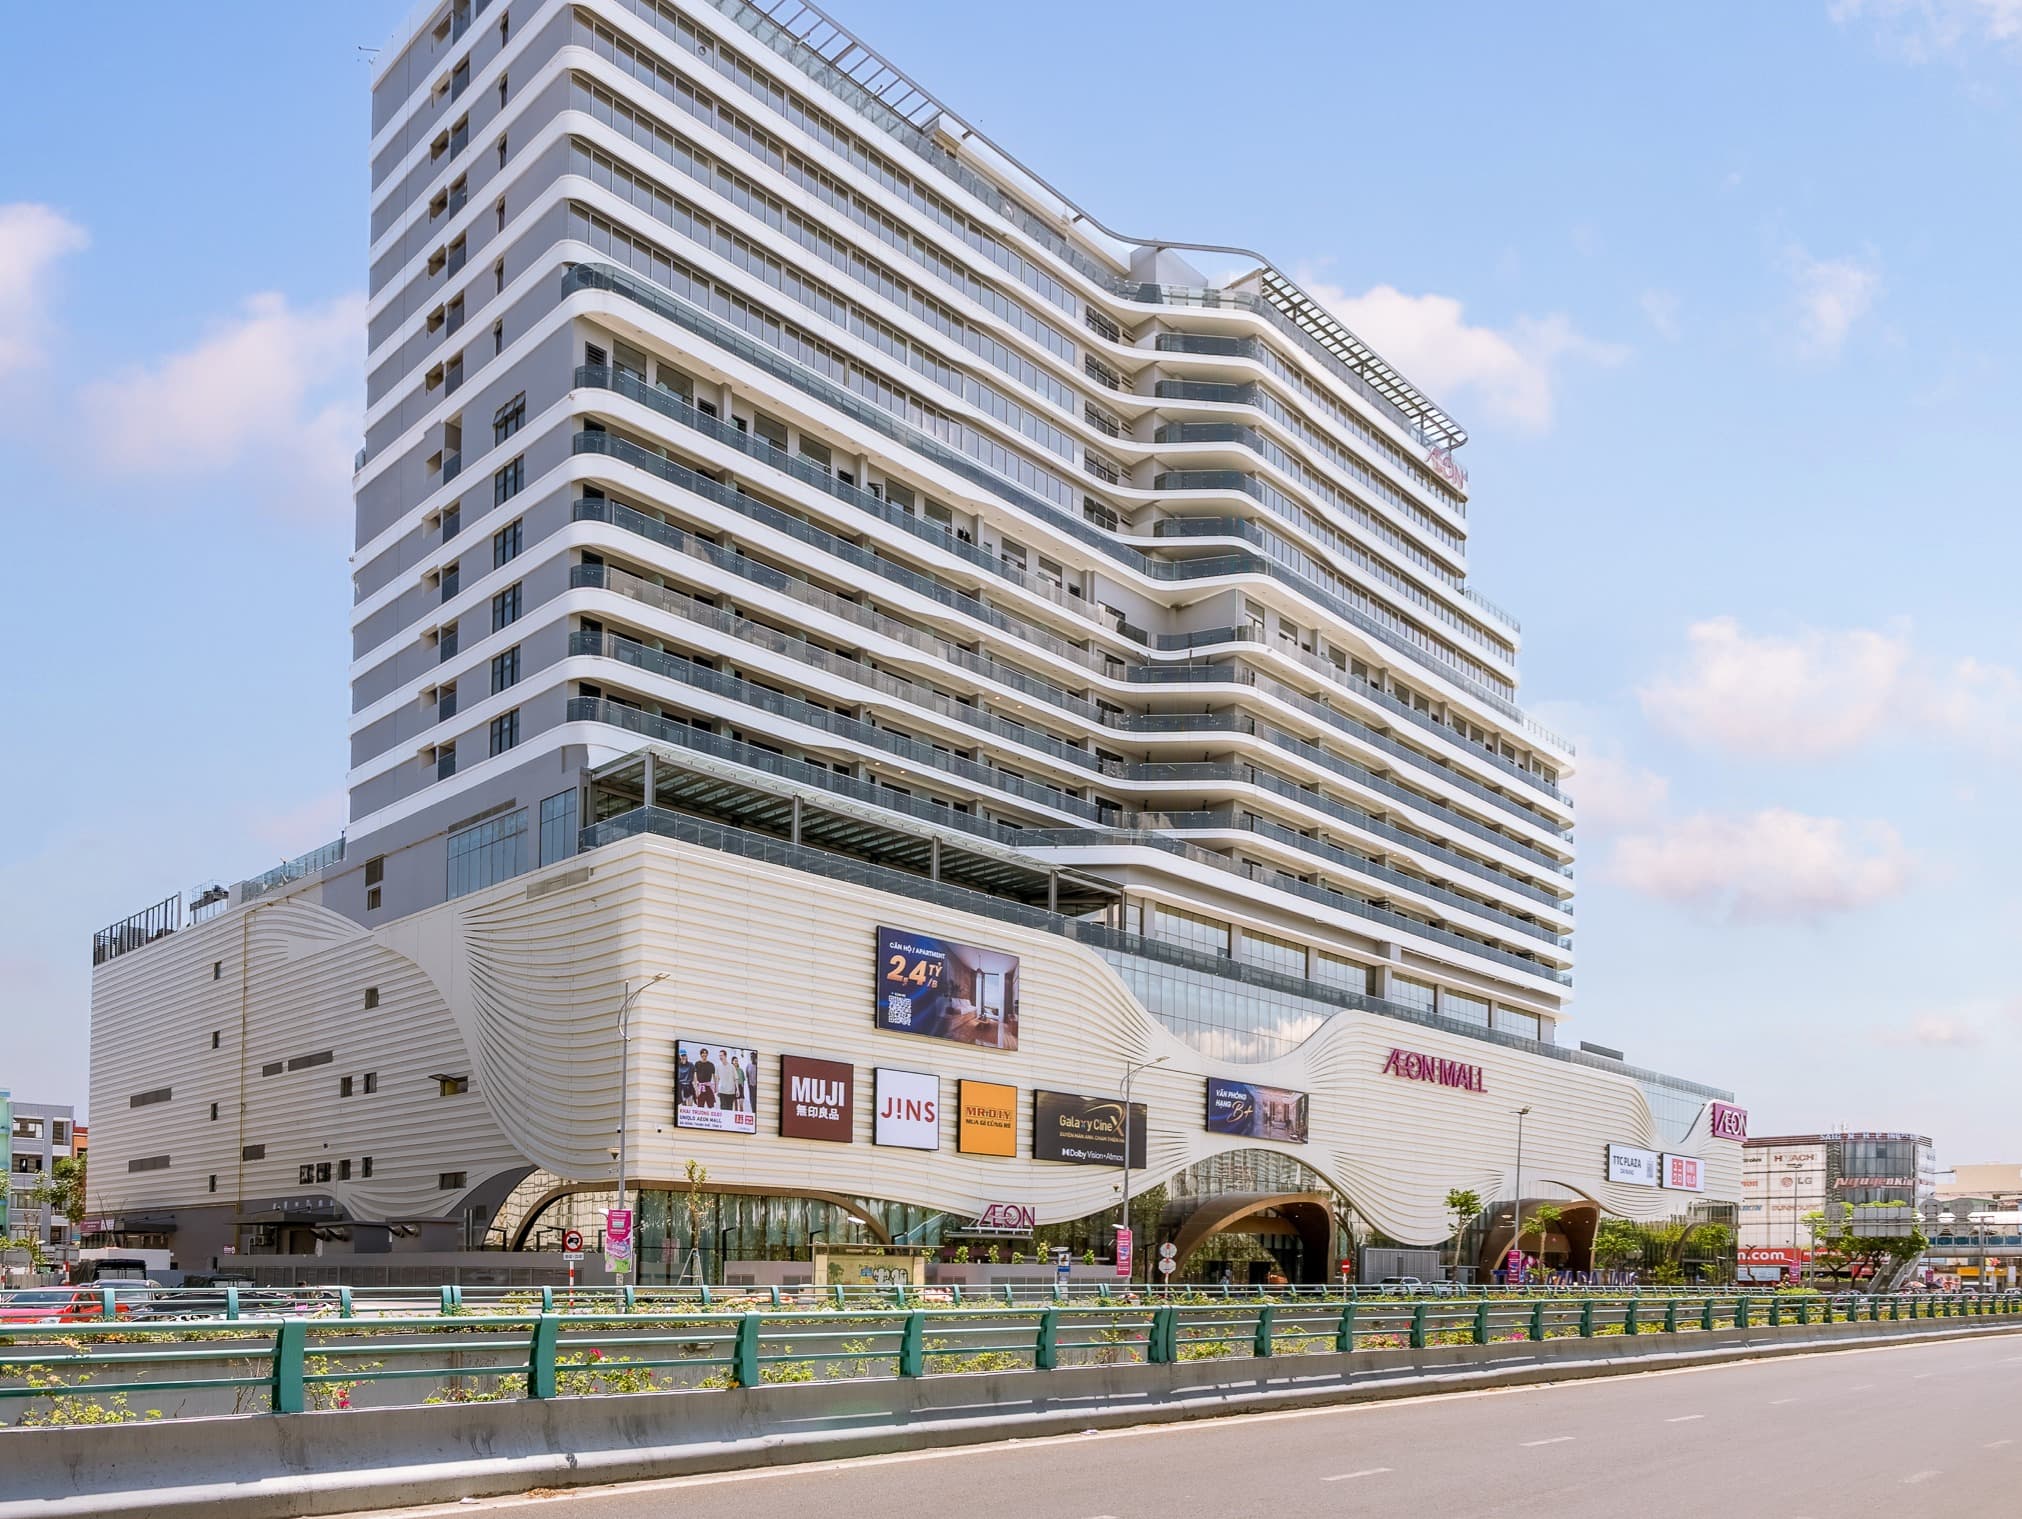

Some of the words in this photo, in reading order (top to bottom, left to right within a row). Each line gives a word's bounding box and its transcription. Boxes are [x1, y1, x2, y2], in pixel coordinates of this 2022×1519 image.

[1440, 1058, 1488, 1093] MALL
[791, 1075, 845, 1107] MUJI
[796, 1103, 840, 1121] 無印良品
[1059, 1114, 1093, 1132] Galaxy
[1069, 1148, 1087, 1160] Dolby
[1624, 1156, 1642, 1169] PLAZA
[1797, 1176, 1813, 1185] LG
